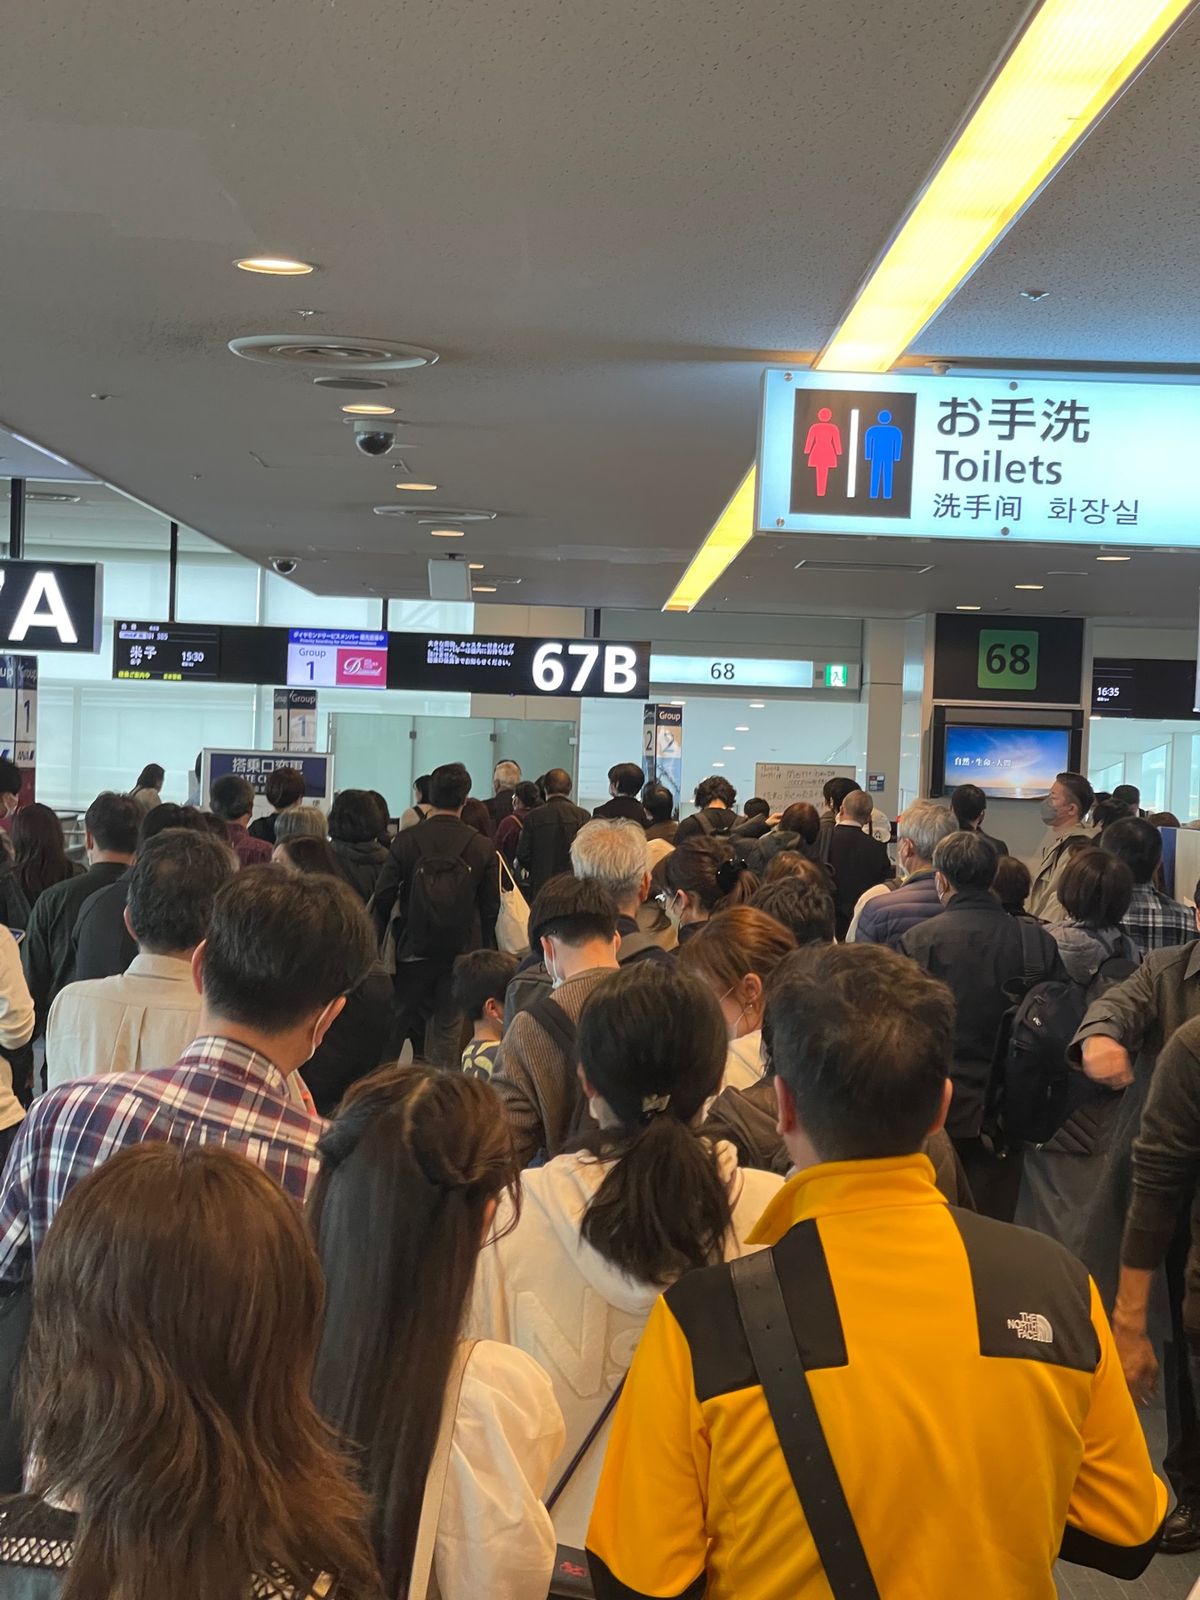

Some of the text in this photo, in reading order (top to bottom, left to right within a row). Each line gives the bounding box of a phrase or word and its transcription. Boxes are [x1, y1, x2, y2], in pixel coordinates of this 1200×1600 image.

[937, 396, 1091, 443] お手洗
[935, 449, 1063, 485] Toilets
[933, 492, 1139, 526] 洗手间 화장실
[130, 645, 157, 660] 米子
[299, 648, 326, 658] Group
[986, 643, 1030, 675] 68
[306, 661, 315, 680] 1
[531, 643, 637, 693] 67B
[710, 662, 735, 680] 68
[292, 694, 316, 705] Group
[1097, 687, 1120, 697] 16:35
[24, 700, 31, 733] 1
[659, 710, 681, 722] Group
[277, 715, 306, 737] 1 1
[645, 730, 675, 753] 2 2
[1007, 1318, 1038, 1332] NORTH
[1019, 1311, 1038, 1321] THE
[1017, 1328, 1038, 1342] FACE
